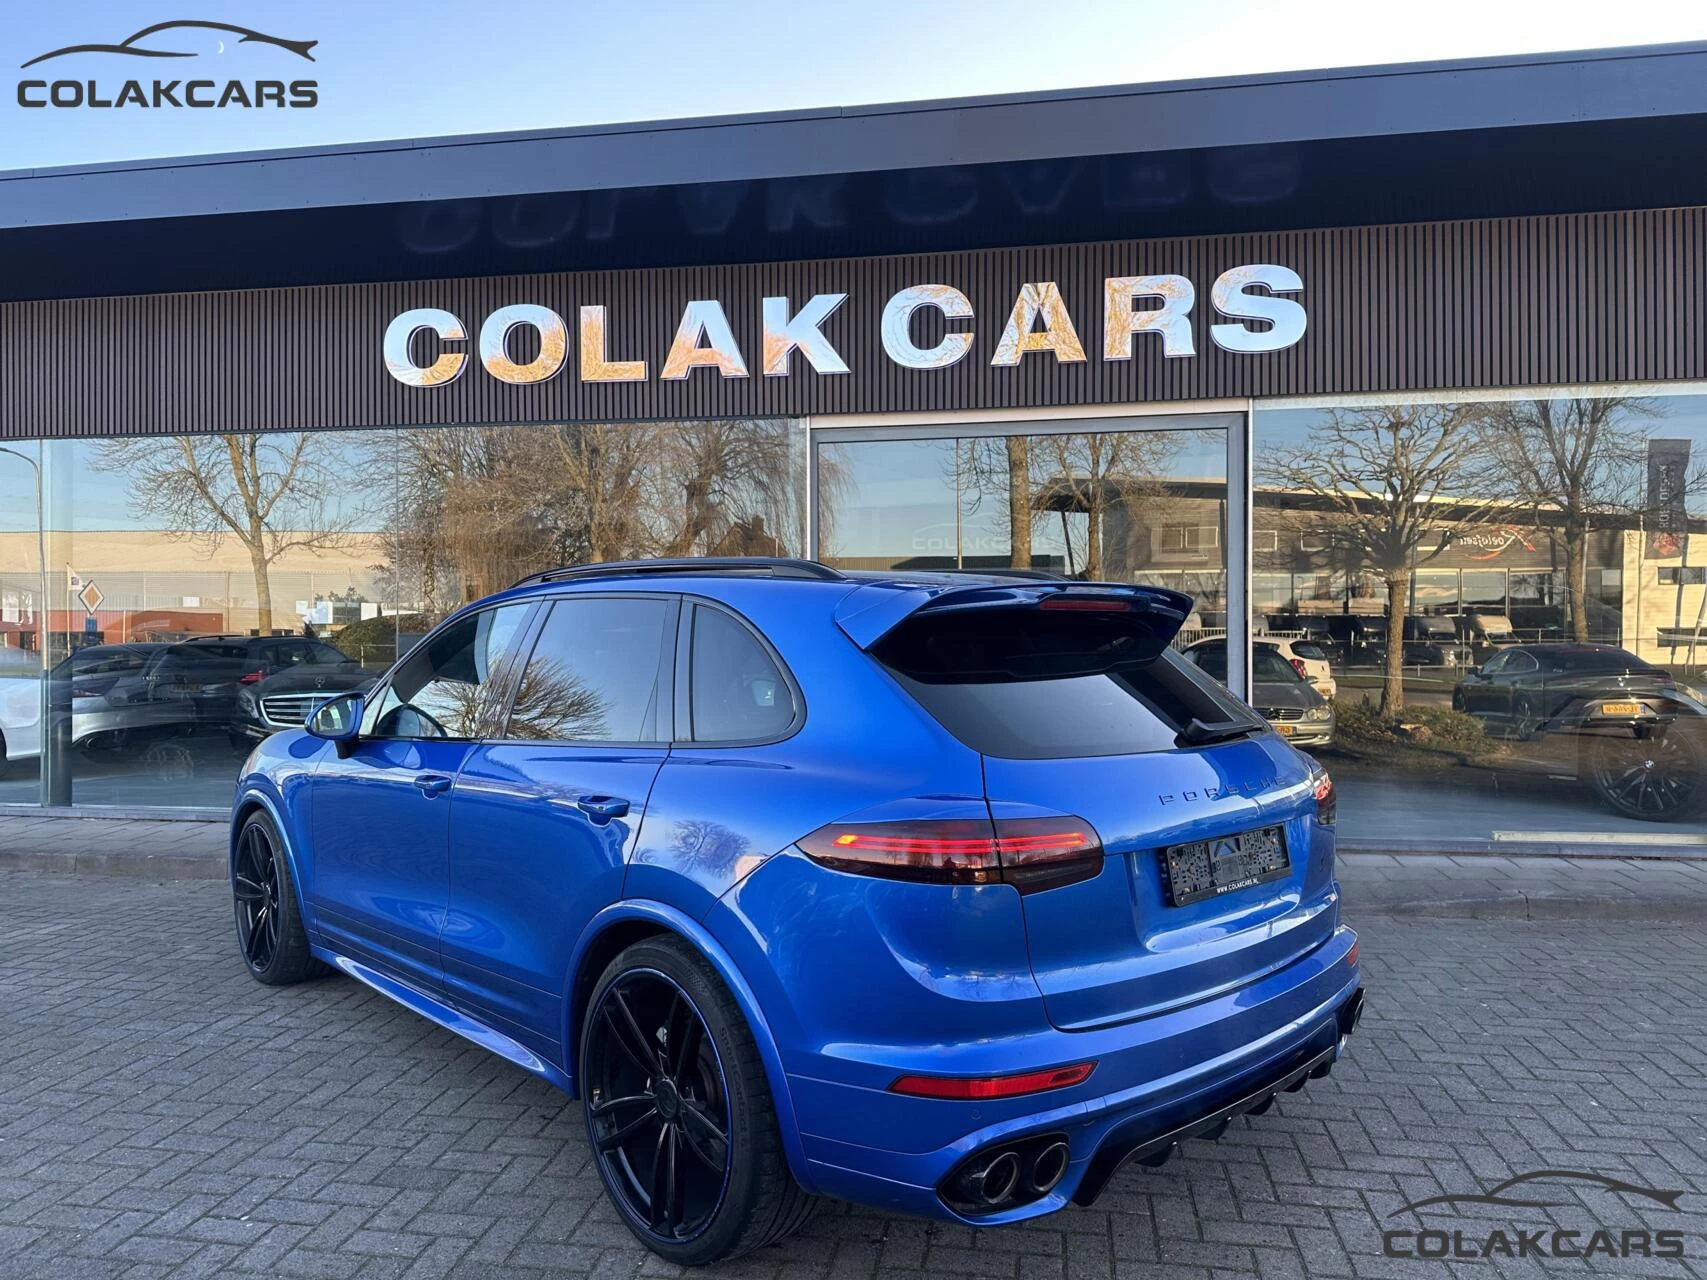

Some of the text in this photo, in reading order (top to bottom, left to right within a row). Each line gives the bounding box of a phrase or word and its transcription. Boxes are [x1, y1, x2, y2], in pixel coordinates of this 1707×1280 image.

[383, 264, 1308, 388] COLAK CARS
[1158, 775, 1286, 806] PORSCHE
